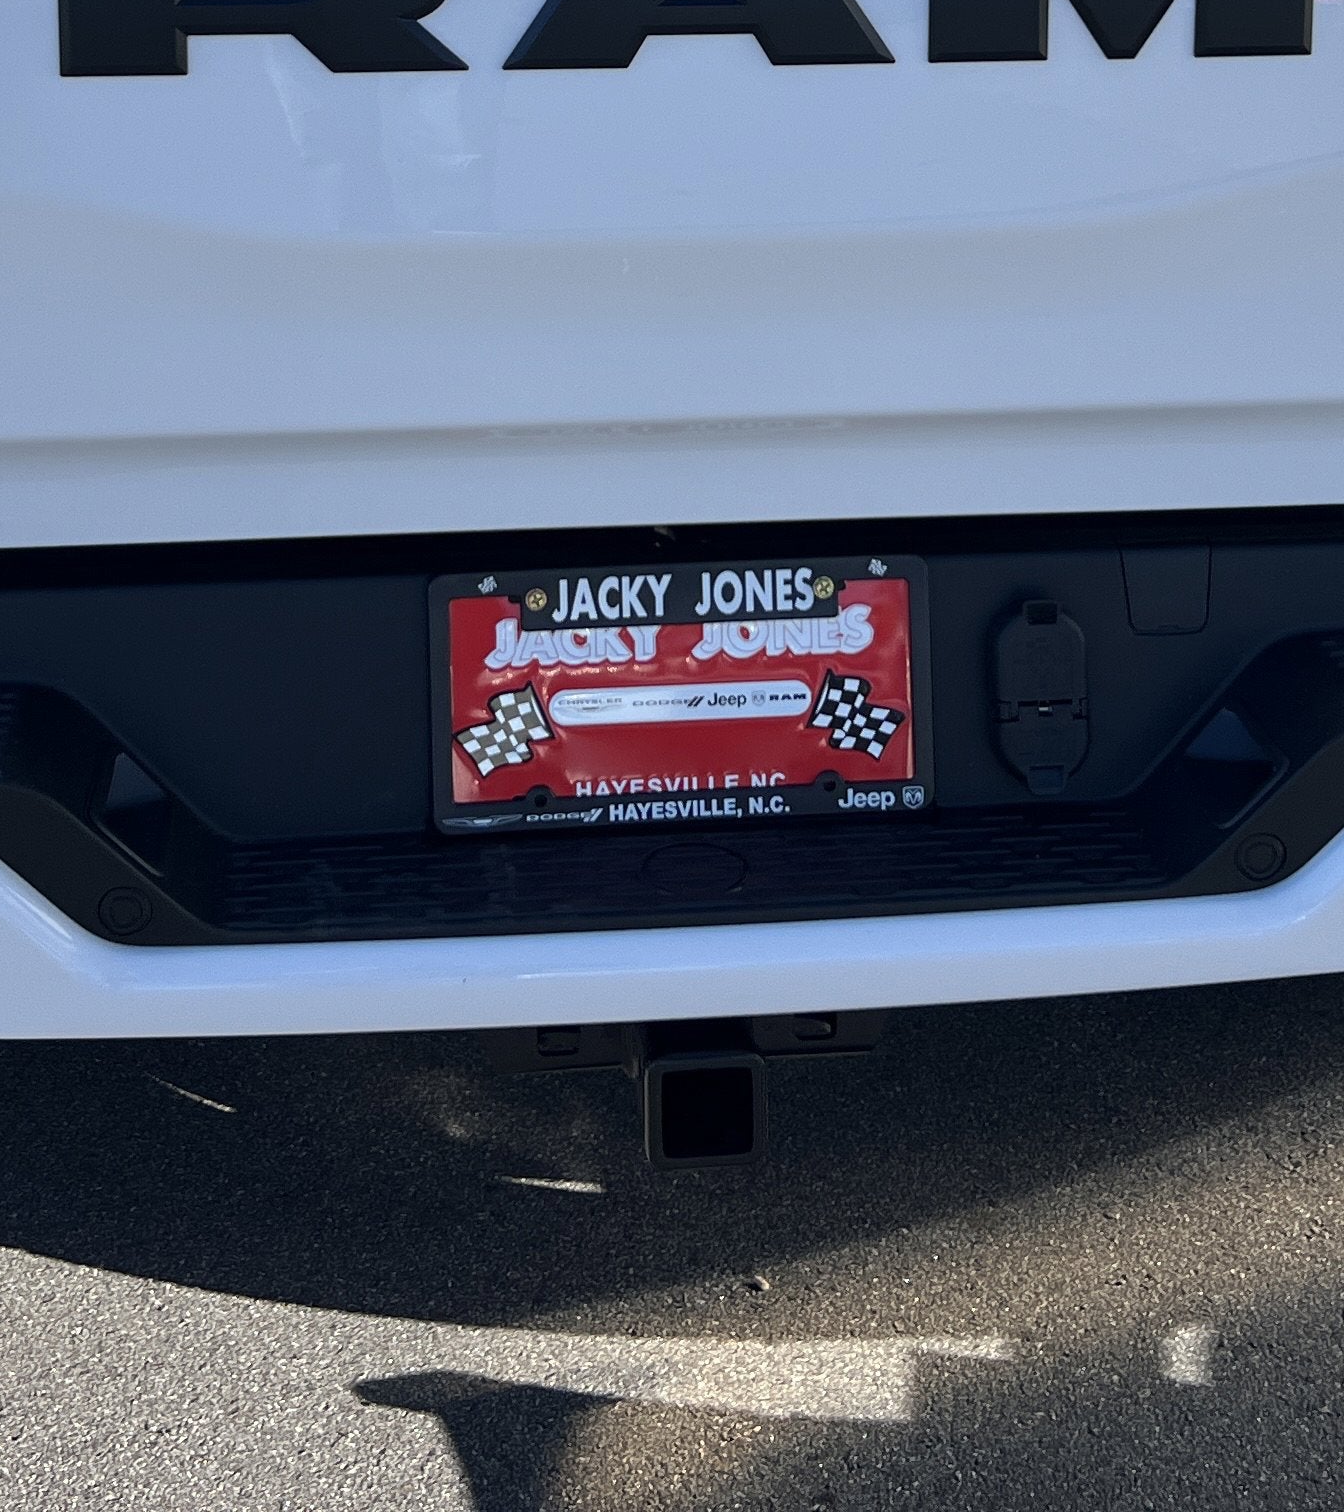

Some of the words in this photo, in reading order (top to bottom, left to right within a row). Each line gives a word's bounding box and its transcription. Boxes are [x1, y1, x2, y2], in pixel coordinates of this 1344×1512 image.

[552, 573, 672, 623] JACKY
[695, 567, 815, 617] JONES
[484, 617, 663, 671] JACKY
[691, 602, 875, 660] JONES
[707, 692, 748, 709] Jeep
[769, 692, 807, 701] RAM
[609, 797, 743, 822] HAYESVILLE,
[749, 795, 791, 815] N.C.
[838, 789, 896, 811] Jeep
